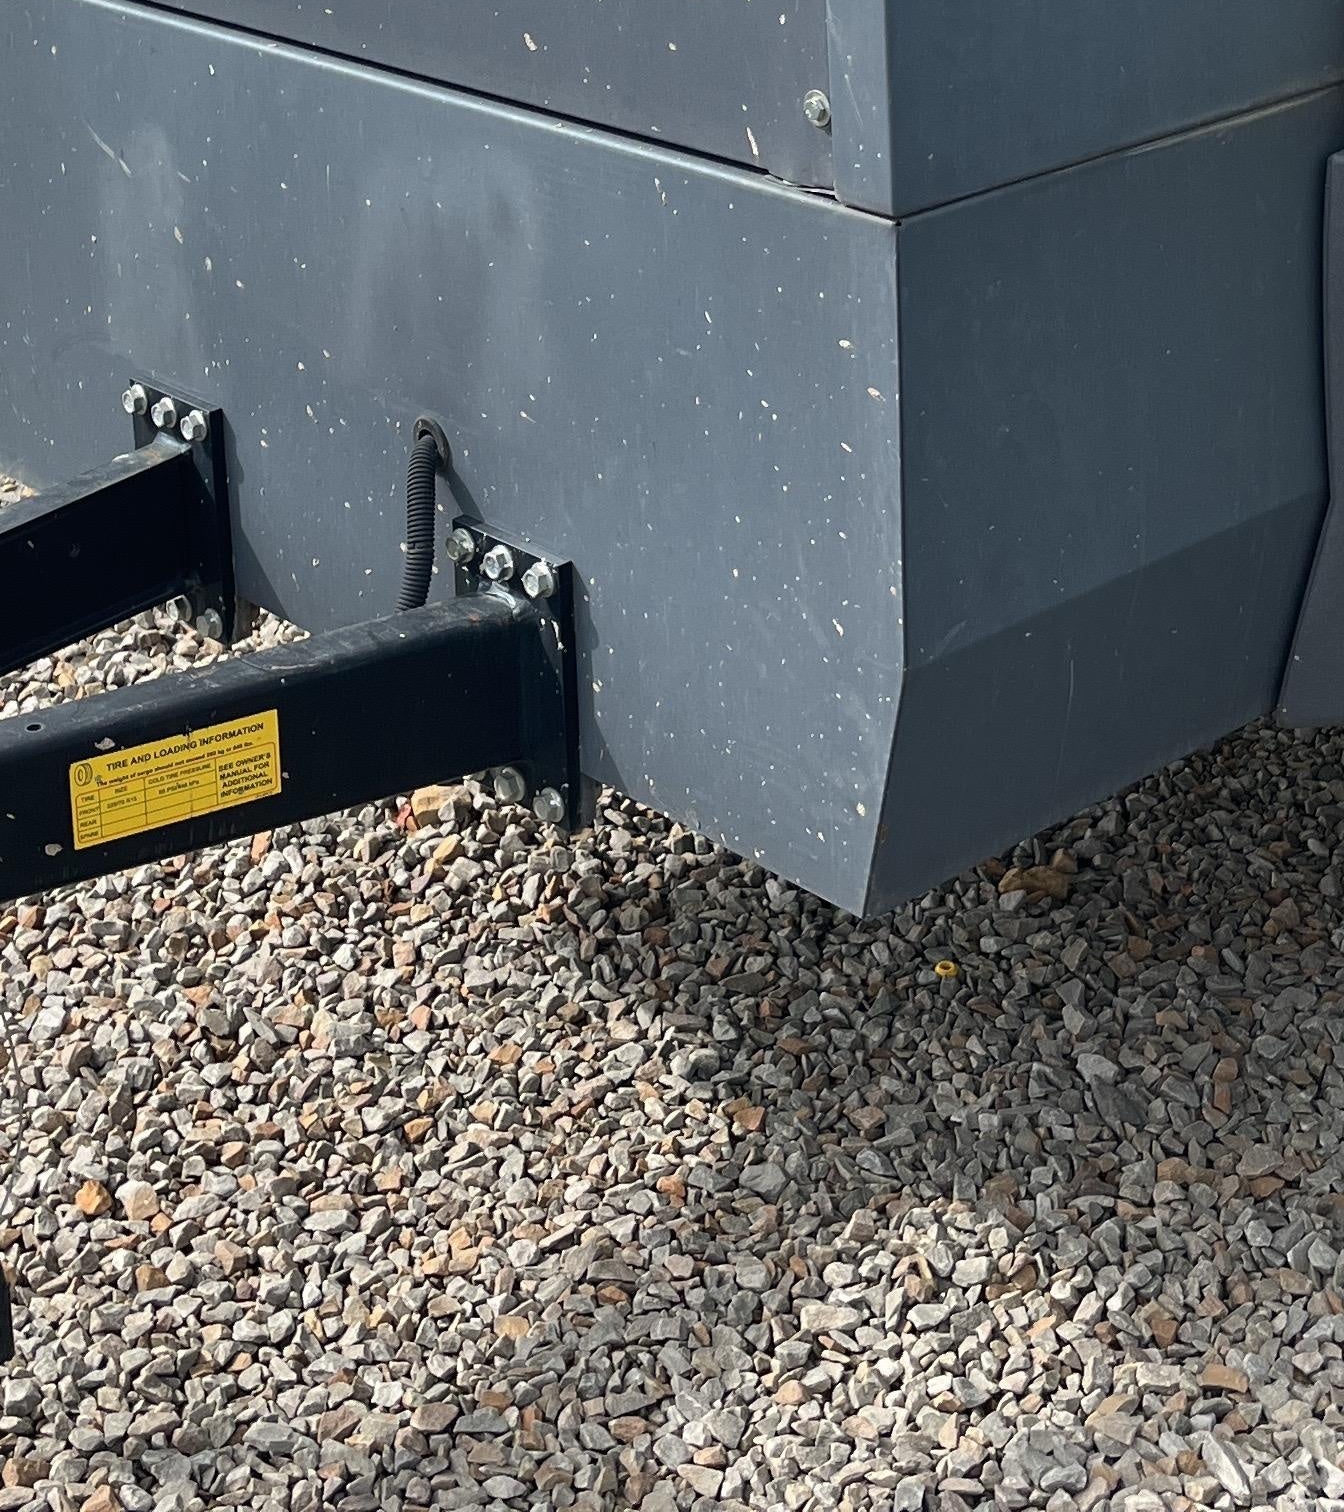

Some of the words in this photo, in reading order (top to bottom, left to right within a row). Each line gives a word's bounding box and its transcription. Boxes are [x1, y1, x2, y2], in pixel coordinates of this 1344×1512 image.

[106, 758, 128, 772] TIRE
[130, 752, 151, 765] AND
[153, 740, 197, 759] LOADING
[199, 722, 264, 750] INFORMATION
[218, 762, 233, 772] SEE
[235, 752, 271, 767] OWNER'S
[219, 766, 253, 781] MANUAL
[253, 760, 270, 771] FOR
[148, 775, 165, 785] COLD
[220, 777, 273, 798] INFORMATION
[222, 771, 268, 789] ADDITIONAL
[80, 794, 95, 803] TIRE
[79, 819, 97, 828] REAR
